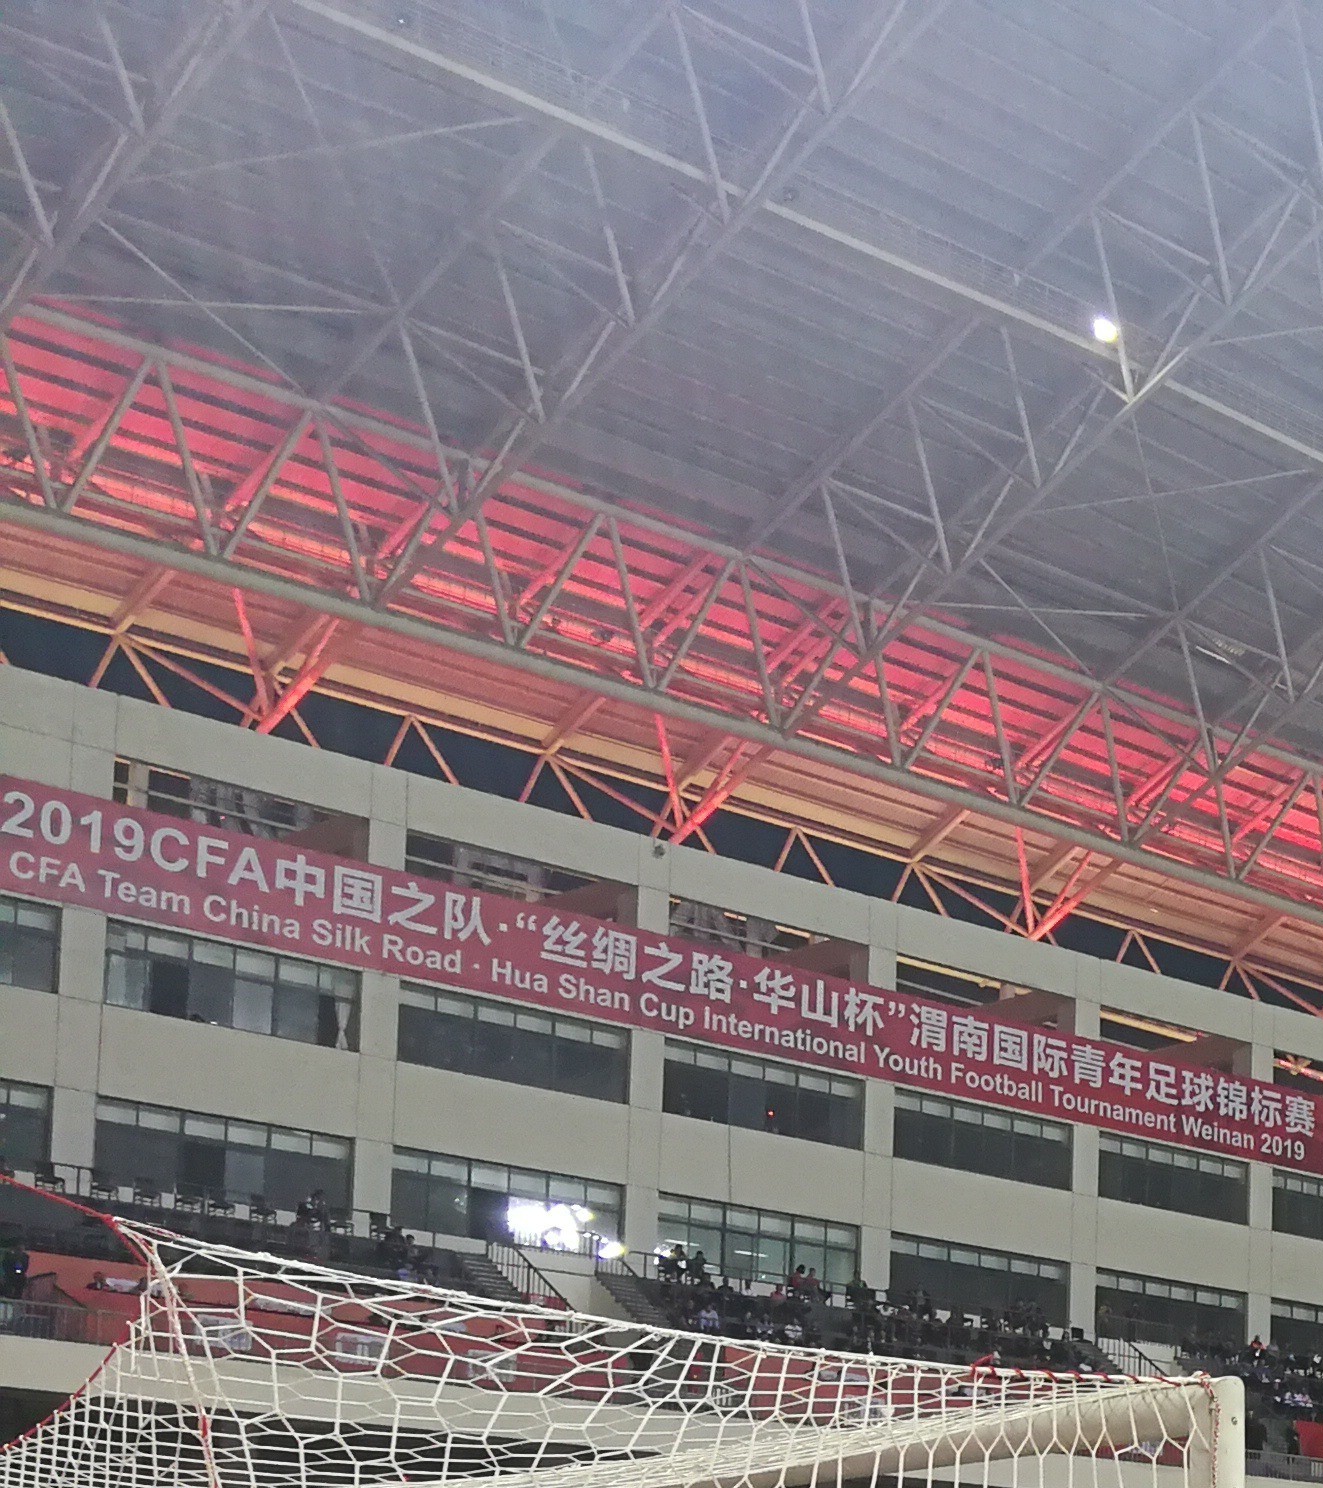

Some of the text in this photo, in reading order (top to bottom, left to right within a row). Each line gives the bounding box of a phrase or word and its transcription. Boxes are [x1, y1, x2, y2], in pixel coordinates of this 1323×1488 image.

[9, 851, 1305, 1160] CFA Team China Silk Road Hua Shan Cup International Youth Football Tournament Weinan 2019
